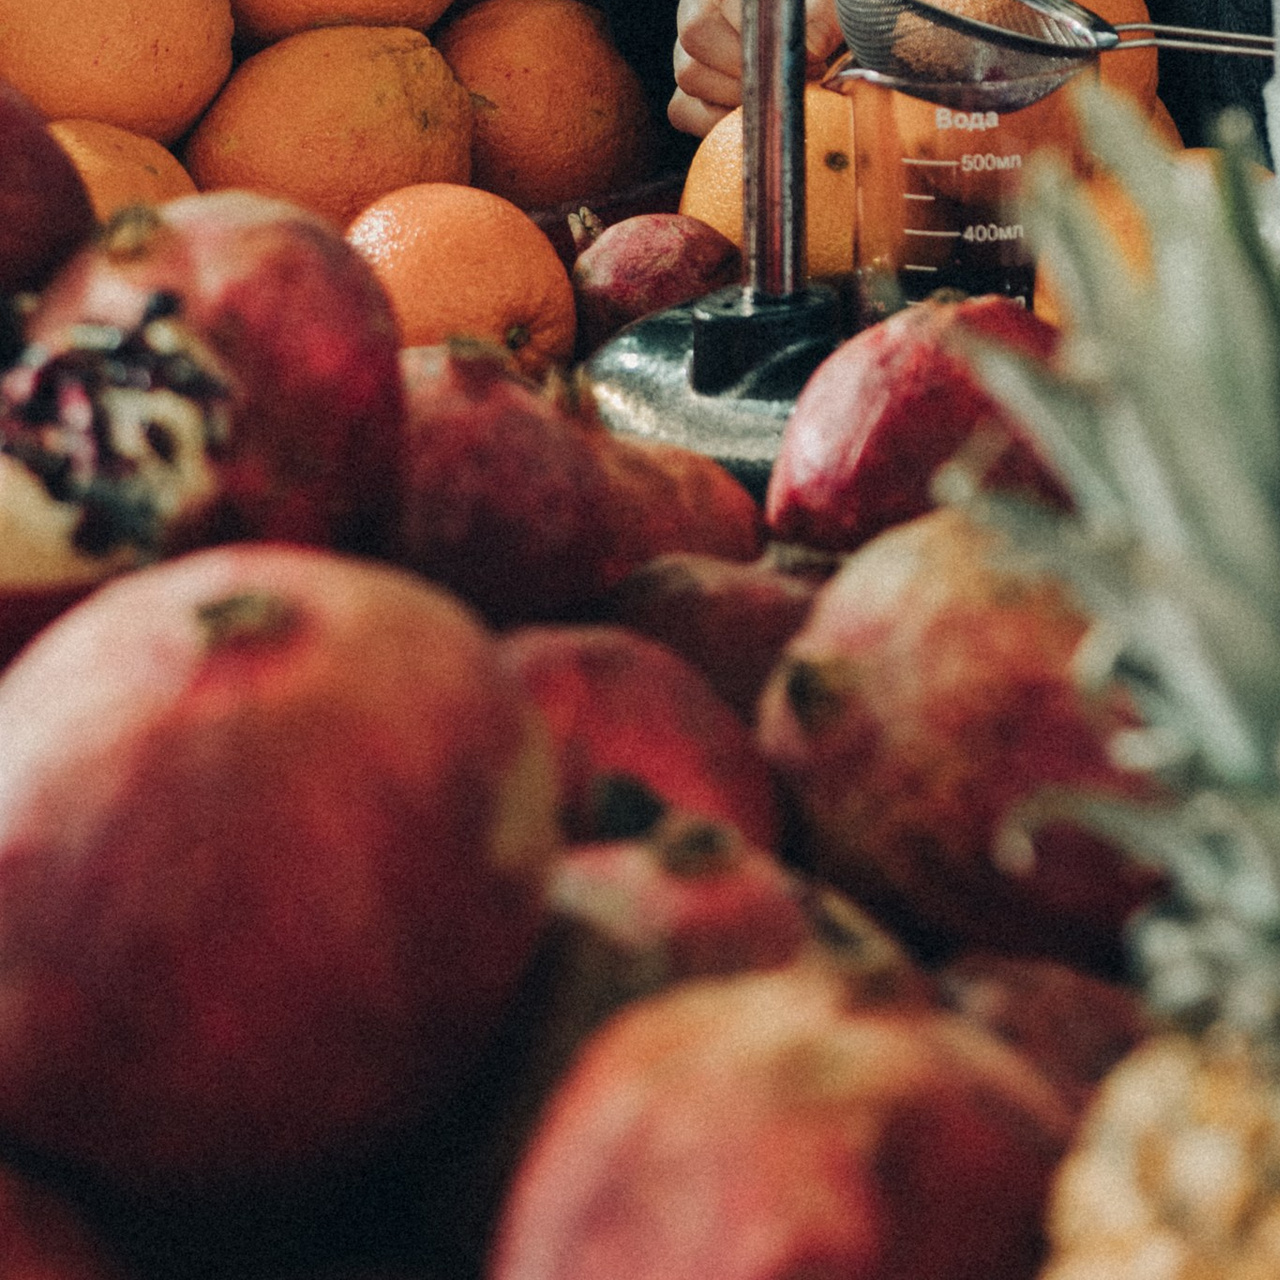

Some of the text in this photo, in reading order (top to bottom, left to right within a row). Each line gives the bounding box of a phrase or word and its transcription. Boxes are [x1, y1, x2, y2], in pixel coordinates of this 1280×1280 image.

[934, 107, 1000, 132] Вода
[961, 153, 1022, 173] 500мл
[962, 223, 1025, 243] 400мл
